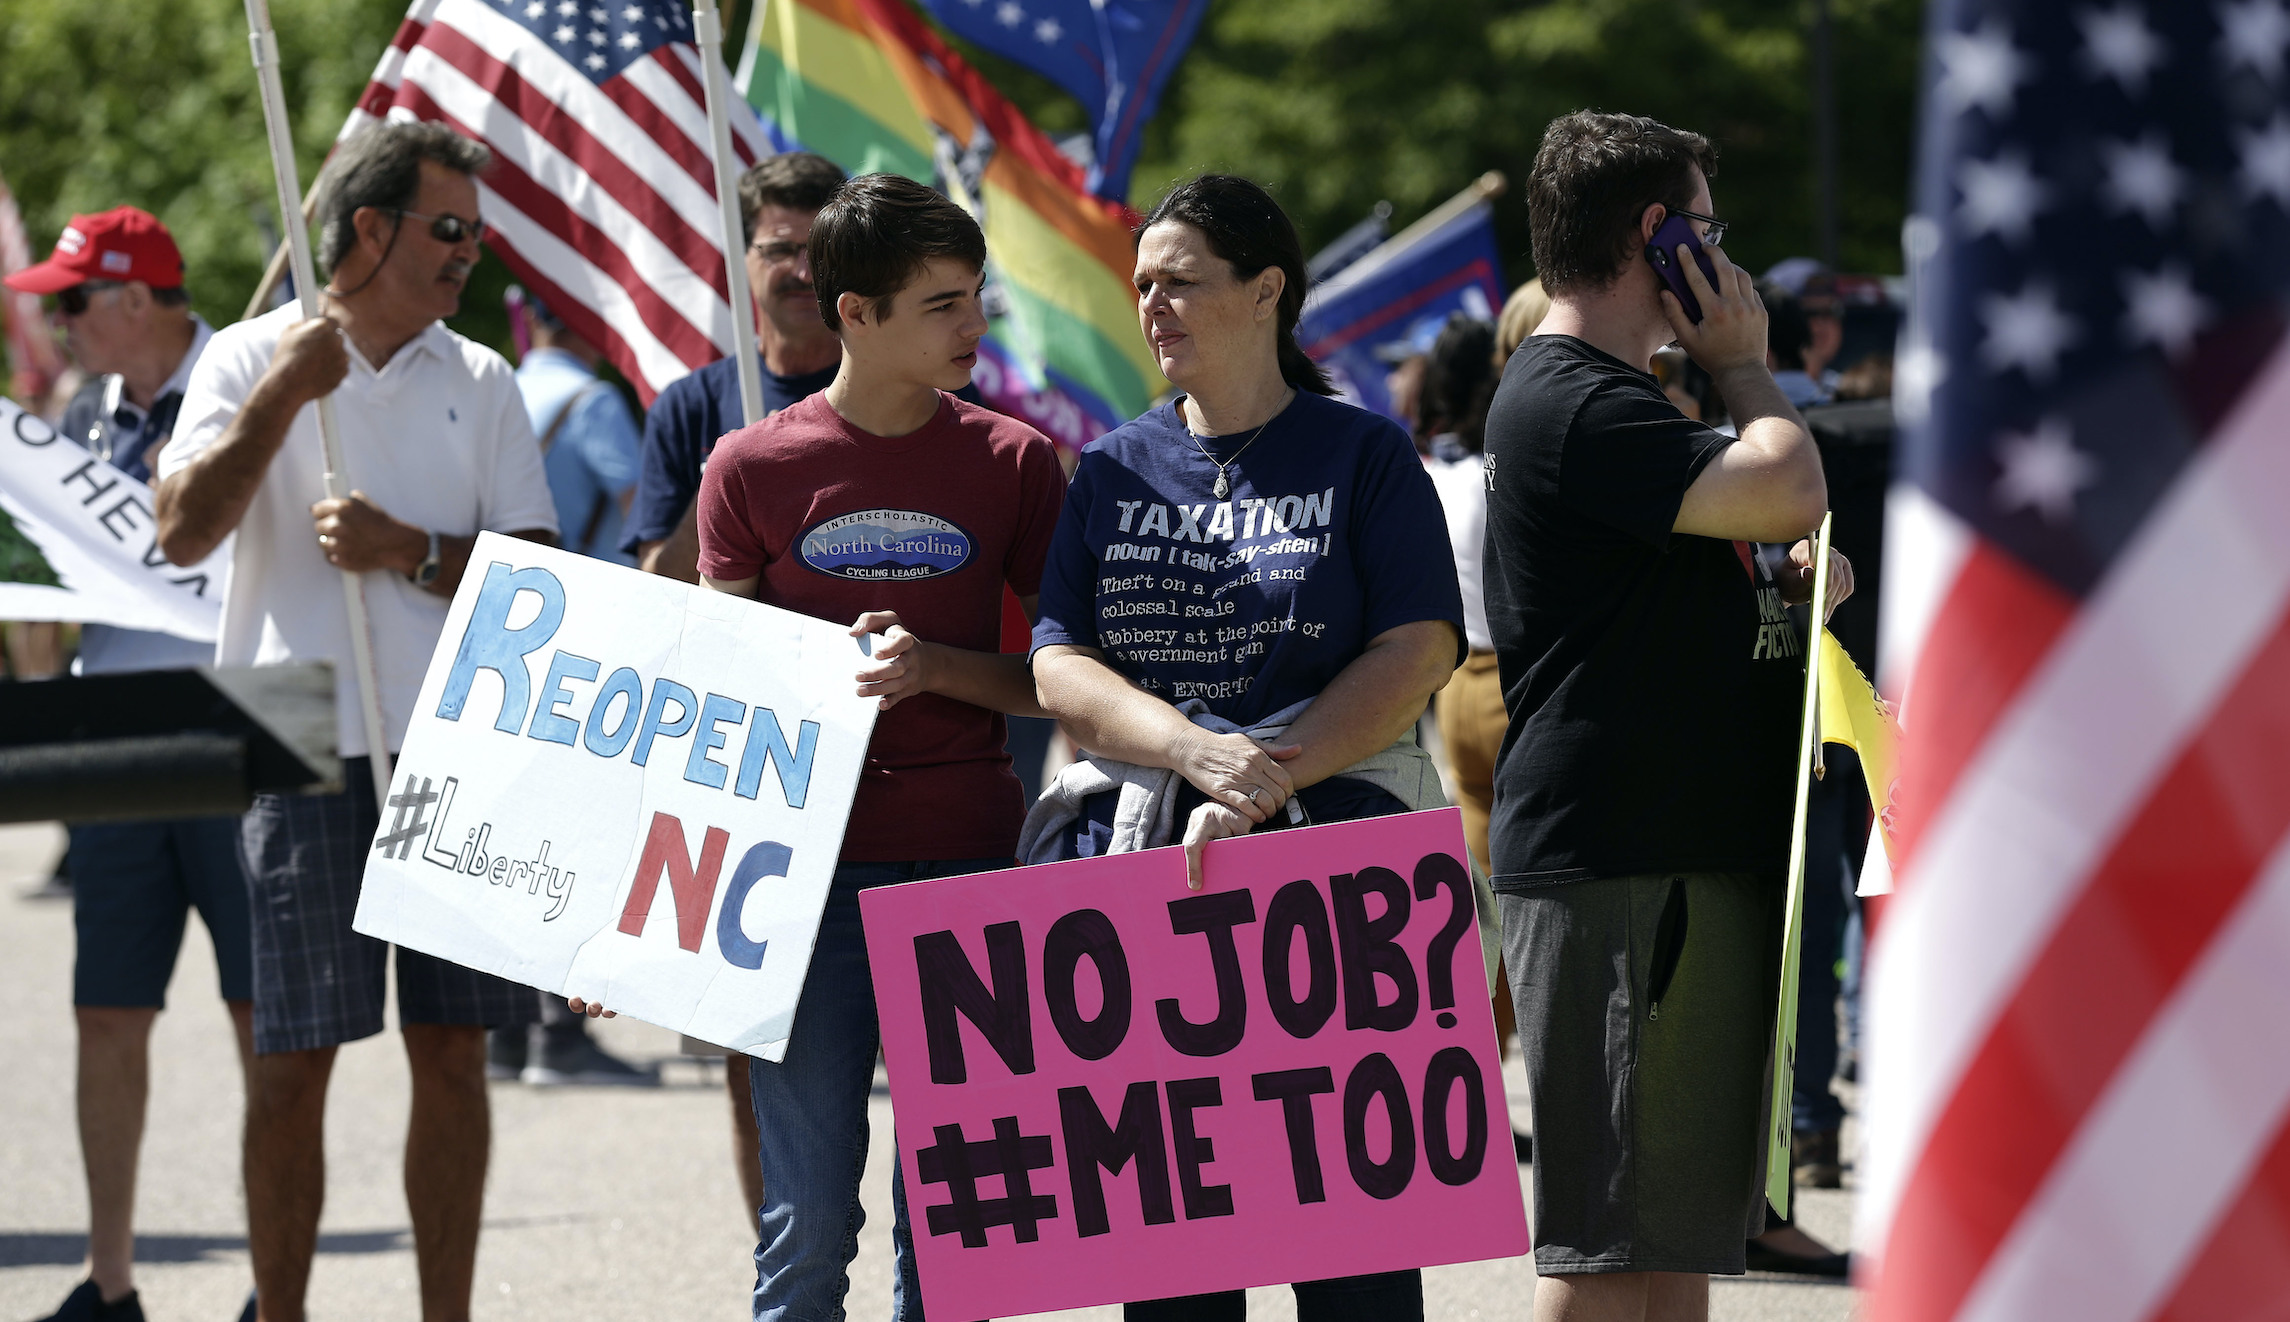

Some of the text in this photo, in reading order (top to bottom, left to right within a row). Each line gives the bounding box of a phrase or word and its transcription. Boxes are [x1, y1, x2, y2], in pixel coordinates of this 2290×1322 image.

[825, 511, 949, 532] INTERSCHOLASTIC
[1115, 486, 1336, 544] TAXATION
[809, 533, 963, 558] North Carolina
[1104, 541, 1162, 562] noun
[845, 565, 930, 578] CYCLING LEAGUE
[1102, 573, 1154, 595] Theft
[1161, 576, 1186, 593] on
[1192, 580, 1206, 595] a
[1269, 565, 1307, 582] and
[1102, 599, 1236, 619] colossal scale
[1107, 626, 1179, 647] Robbery
[1184, 629, 1208, 645] at
[1215, 625, 1248, 644] the
[1249, 615, 1297, 639] point
[1302, 621, 1326, 639] of
[435, 560, 821, 810] REOPEN
[375, 773, 576, 922] #Liberty
[616, 810, 794, 971] NC
[913, 852, 1476, 1085] NO JOB?
[916, 1047, 1489, 1249] #ME TOO
